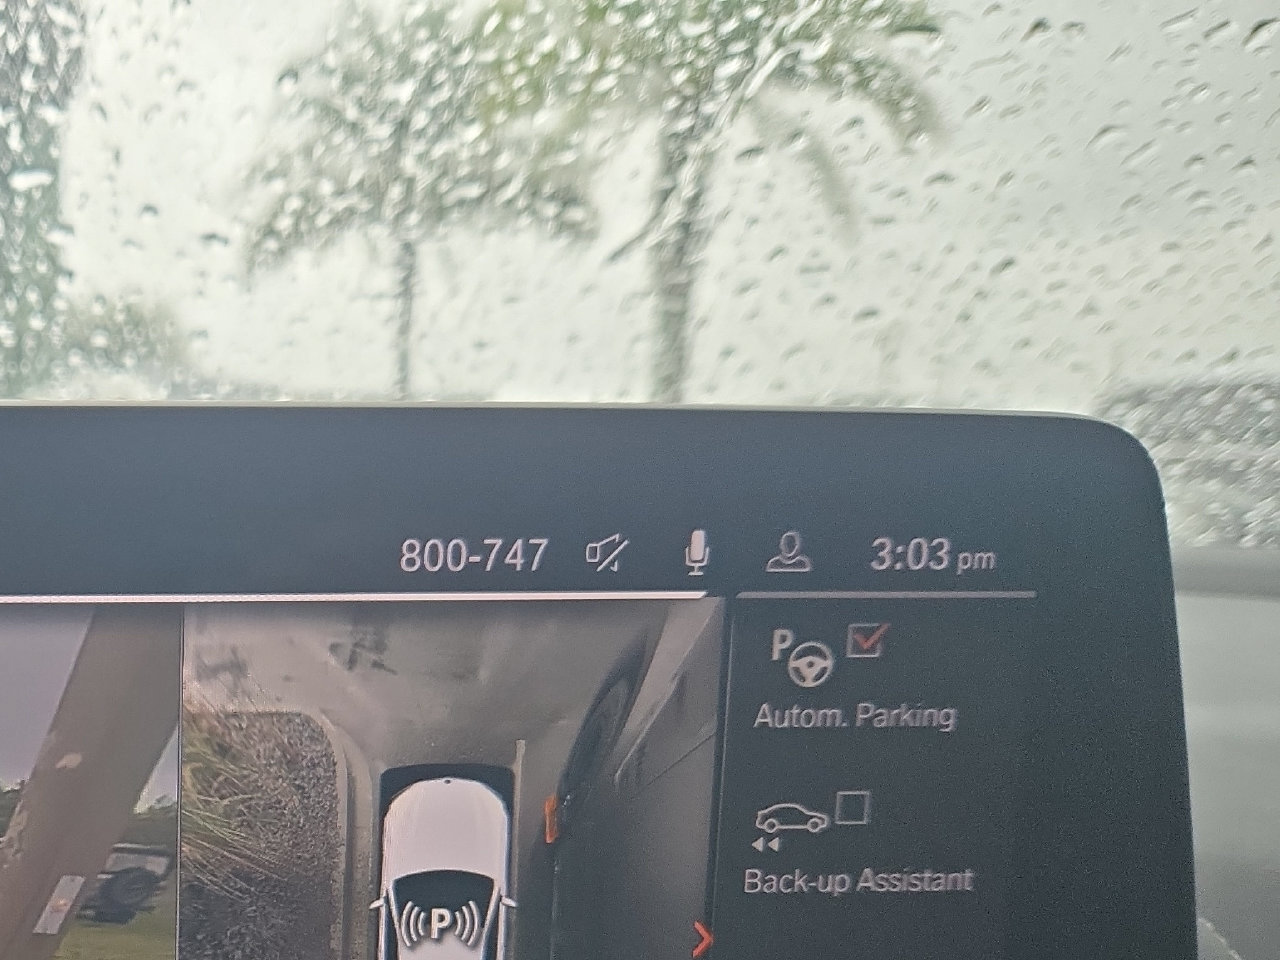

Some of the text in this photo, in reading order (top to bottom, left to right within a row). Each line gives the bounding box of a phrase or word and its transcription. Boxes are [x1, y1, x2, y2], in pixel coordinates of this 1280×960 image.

[400, 538, 549, 573] 800-747
[869, 536, 997, 576] 3:03 pm
[754, 702, 958, 732] Autom. Parking
[743, 867, 974, 896] Back-up Assistant
